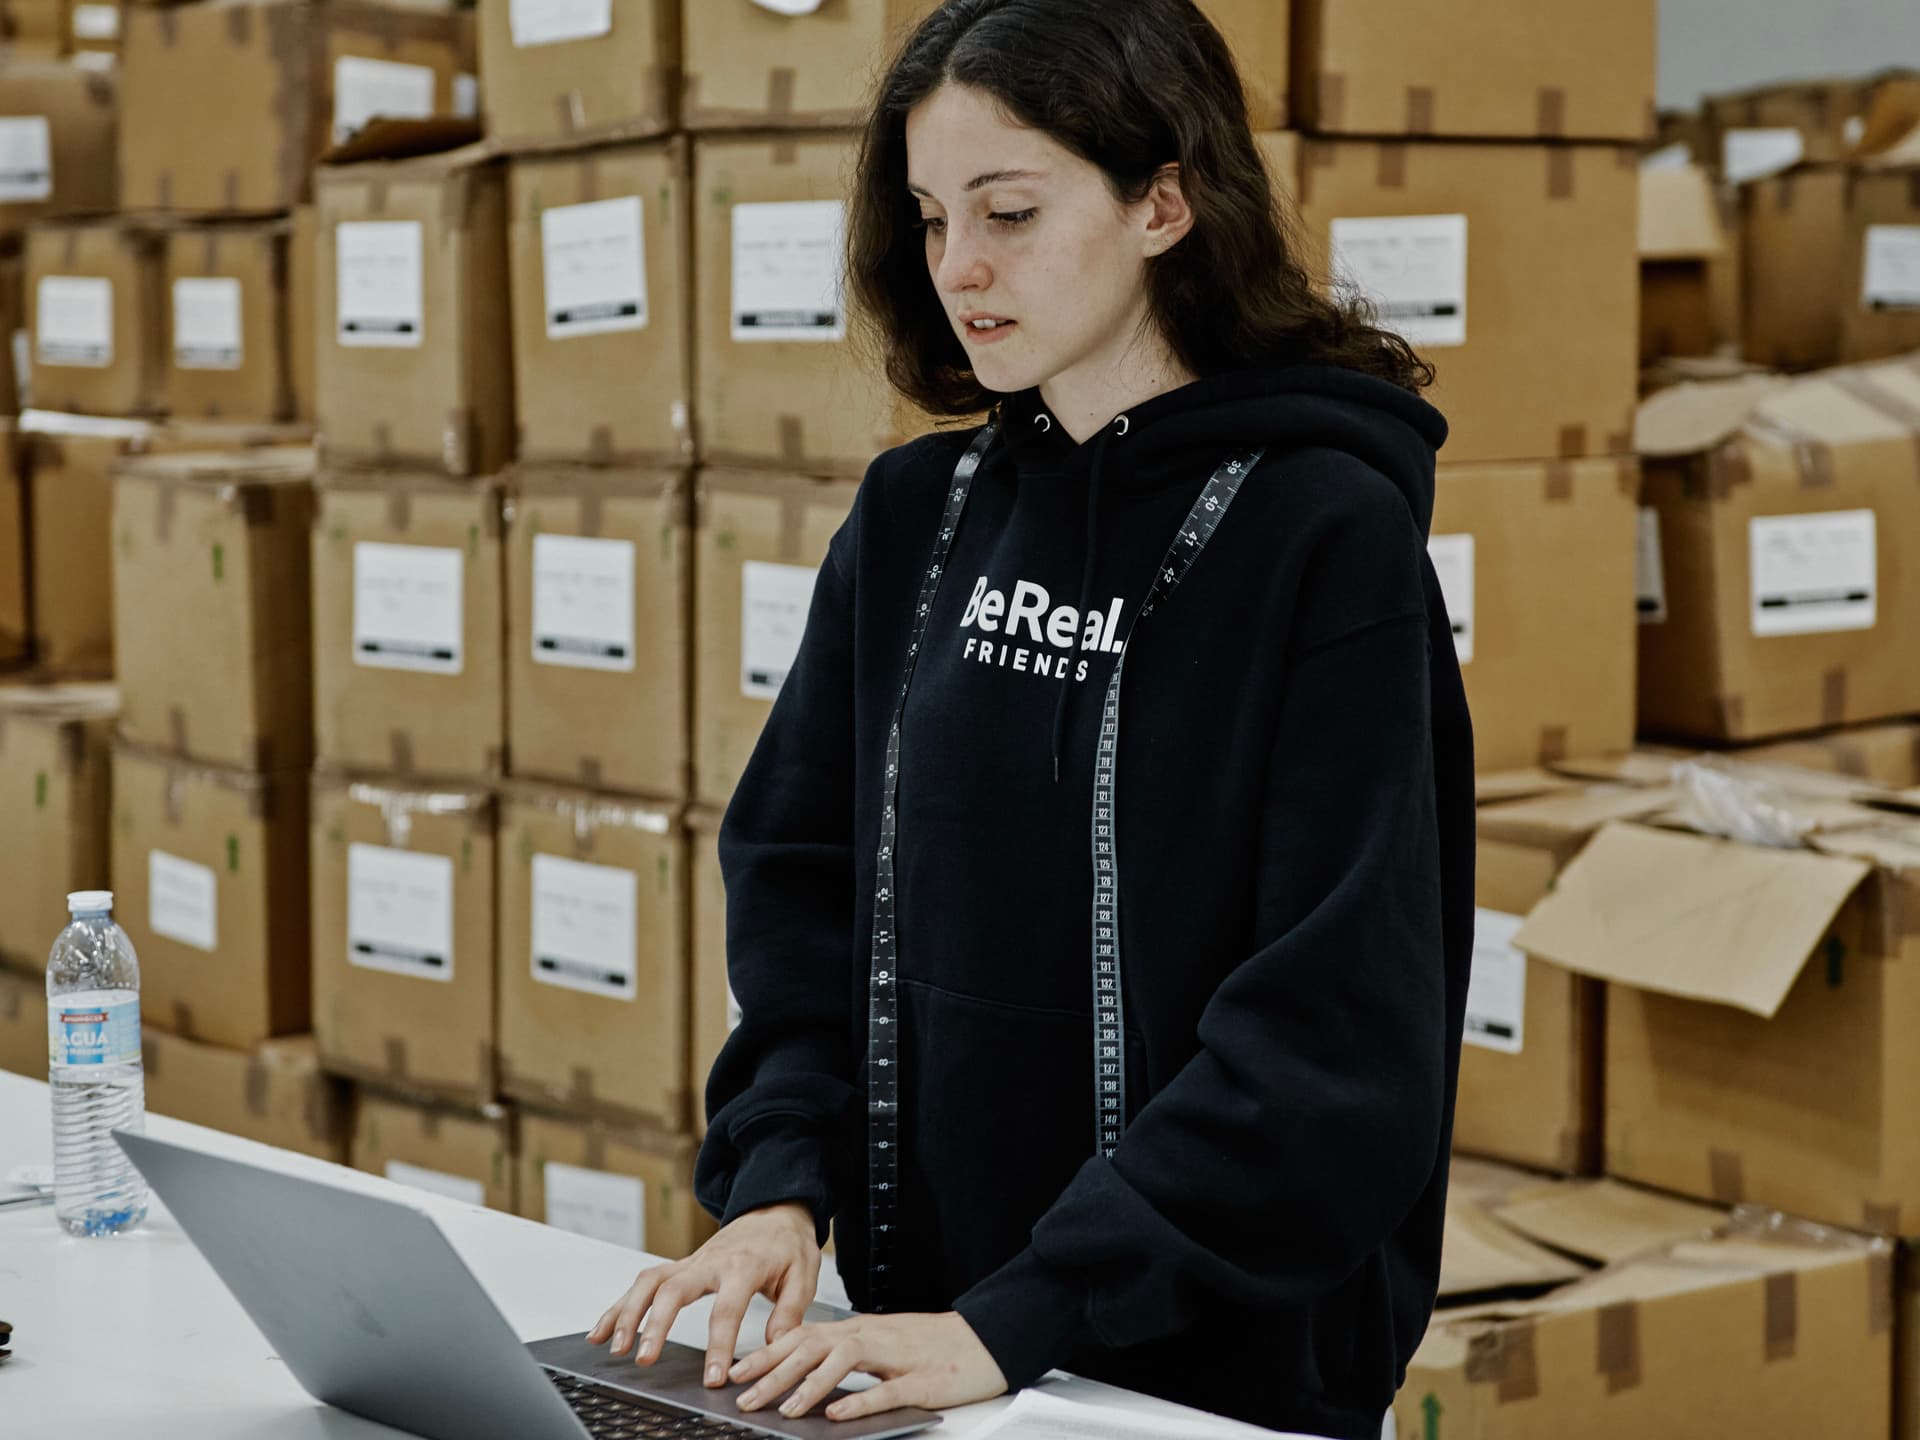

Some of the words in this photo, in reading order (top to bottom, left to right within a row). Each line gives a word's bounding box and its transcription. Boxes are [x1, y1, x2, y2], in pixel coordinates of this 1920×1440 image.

[1226, 460, 1242, 475] 39
[953, 487, 964, 503] 22
[1204, 495, 1219, 511] 40
[942, 527, 951, 541] 21
[1184, 531, 1198, 547] 41
[930, 564, 940, 580] 20
[1163, 567, 1176, 583] 42
[960, 576, 1124, 653] BeReal.
[963, 638, 1089, 681] FRIENDS
[1106, 723, 1115, 733] 117
[1099, 791, 1108, 801] 121
[1098, 808, 1108, 818] 122
[1098, 825, 1108, 835] 123
[1098, 842, 1109, 853] 124
[1099, 859, 1110, 870] 125
[1100, 876, 1111, 887] 126
[1100, 893, 1111, 904] 127
[1099, 910, 1110, 921] 128
[1099, 927, 1111, 938] 129
[1100, 945, 1111, 955] 130
[1100, 962, 1111, 972] 131
[878, 970, 889, 986] 10
[1100, 979, 1113, 989] 132
[1101, 996, 1114, 1006] 133
[878, 1016, 890, 1025] 9
[1102, 1012, 1115, 1023] 134
[1103, 1029, 1116, 1040] 135
[878, 1058, 890, 1067] 8
[1103, 1063, 1116, 1074] 137
[1103, 1080, 1117, 1091] 138
[878, 1099, 889, 1108] 7
[1104, 1097, 1117, 1108] 139
[1104, 1114, 1118, 1126] 140
[1105, 1131, 1117, 1142] 141
[878, 1140, 890, 1149] 6
[878, 1182, 890, 1190] 5
[879, 1224, 889, 1232] 4
